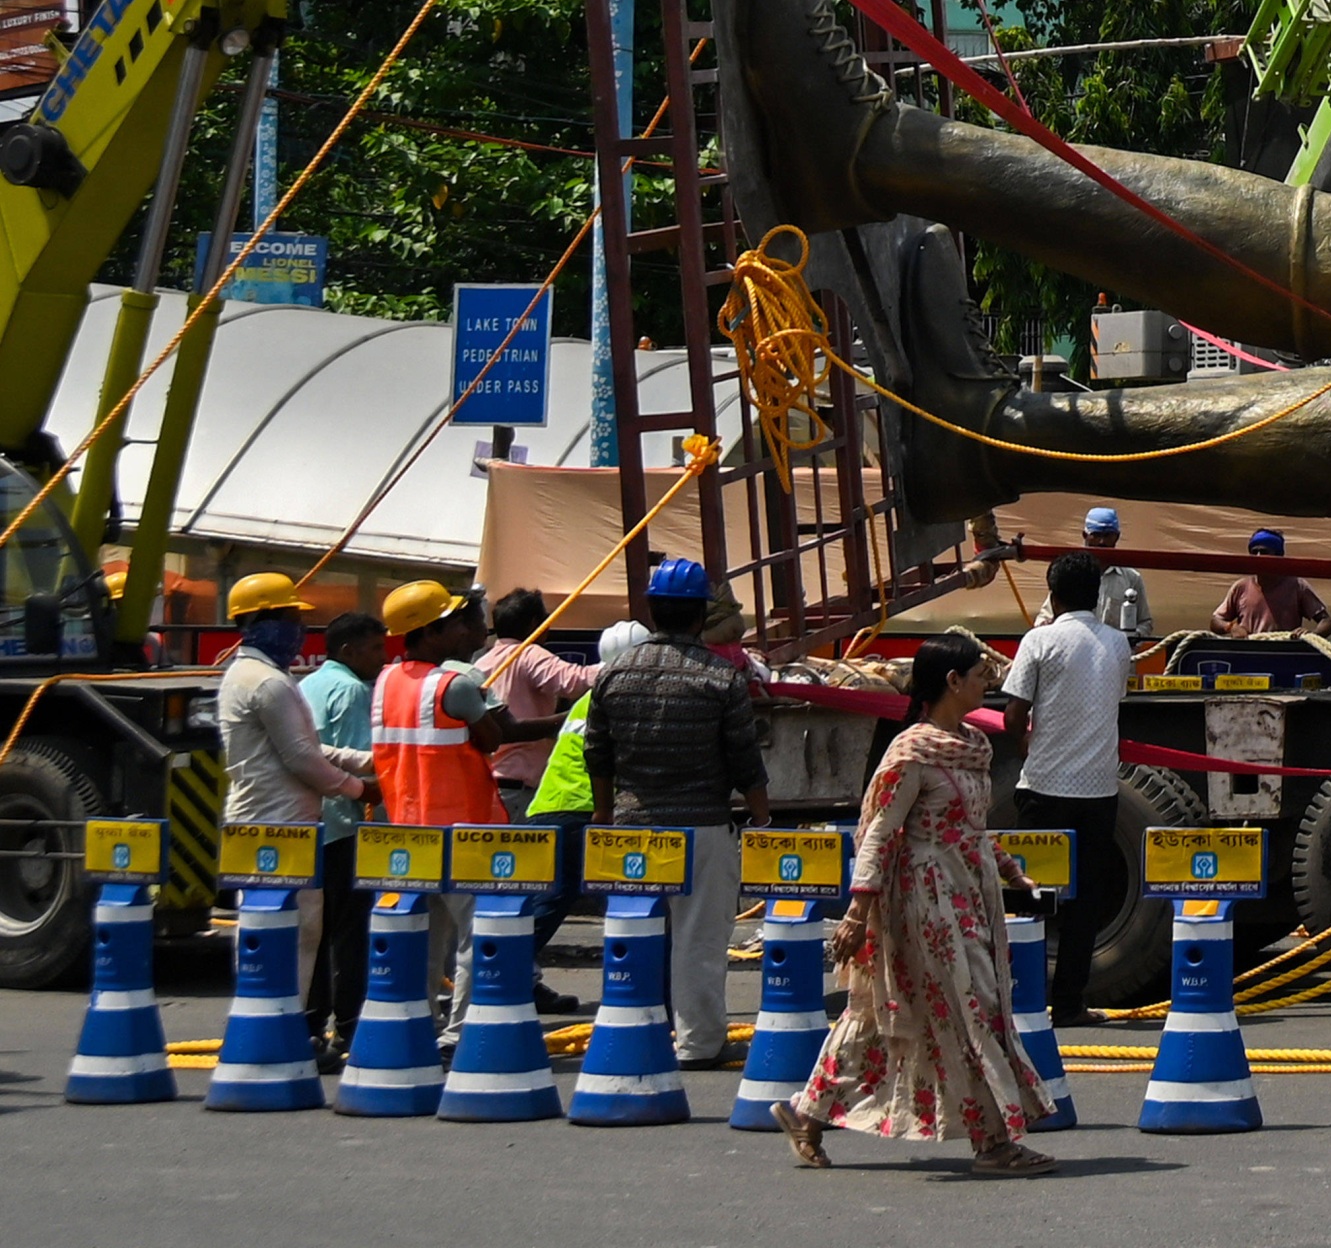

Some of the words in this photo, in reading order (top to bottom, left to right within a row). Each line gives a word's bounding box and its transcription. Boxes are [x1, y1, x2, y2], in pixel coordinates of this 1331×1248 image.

[230, 241, 317, 256] ECOME
[263, 258, 316, 268] LIONEL
[466, 318, 499, 331] LAKE
[463, 349, 538, 362] PEDETRIAN
[508, 380, 539, 393] PASS
[226, 826, 260, 837] UCO
[266, 827, 311, 839] BANK
[457, 832, 495, 843] UCO
[501, 832, 550, 843] BANK
[1008, 834, 1063, 846] BANK
[1150, 831, 1212, 849] ইউকো
